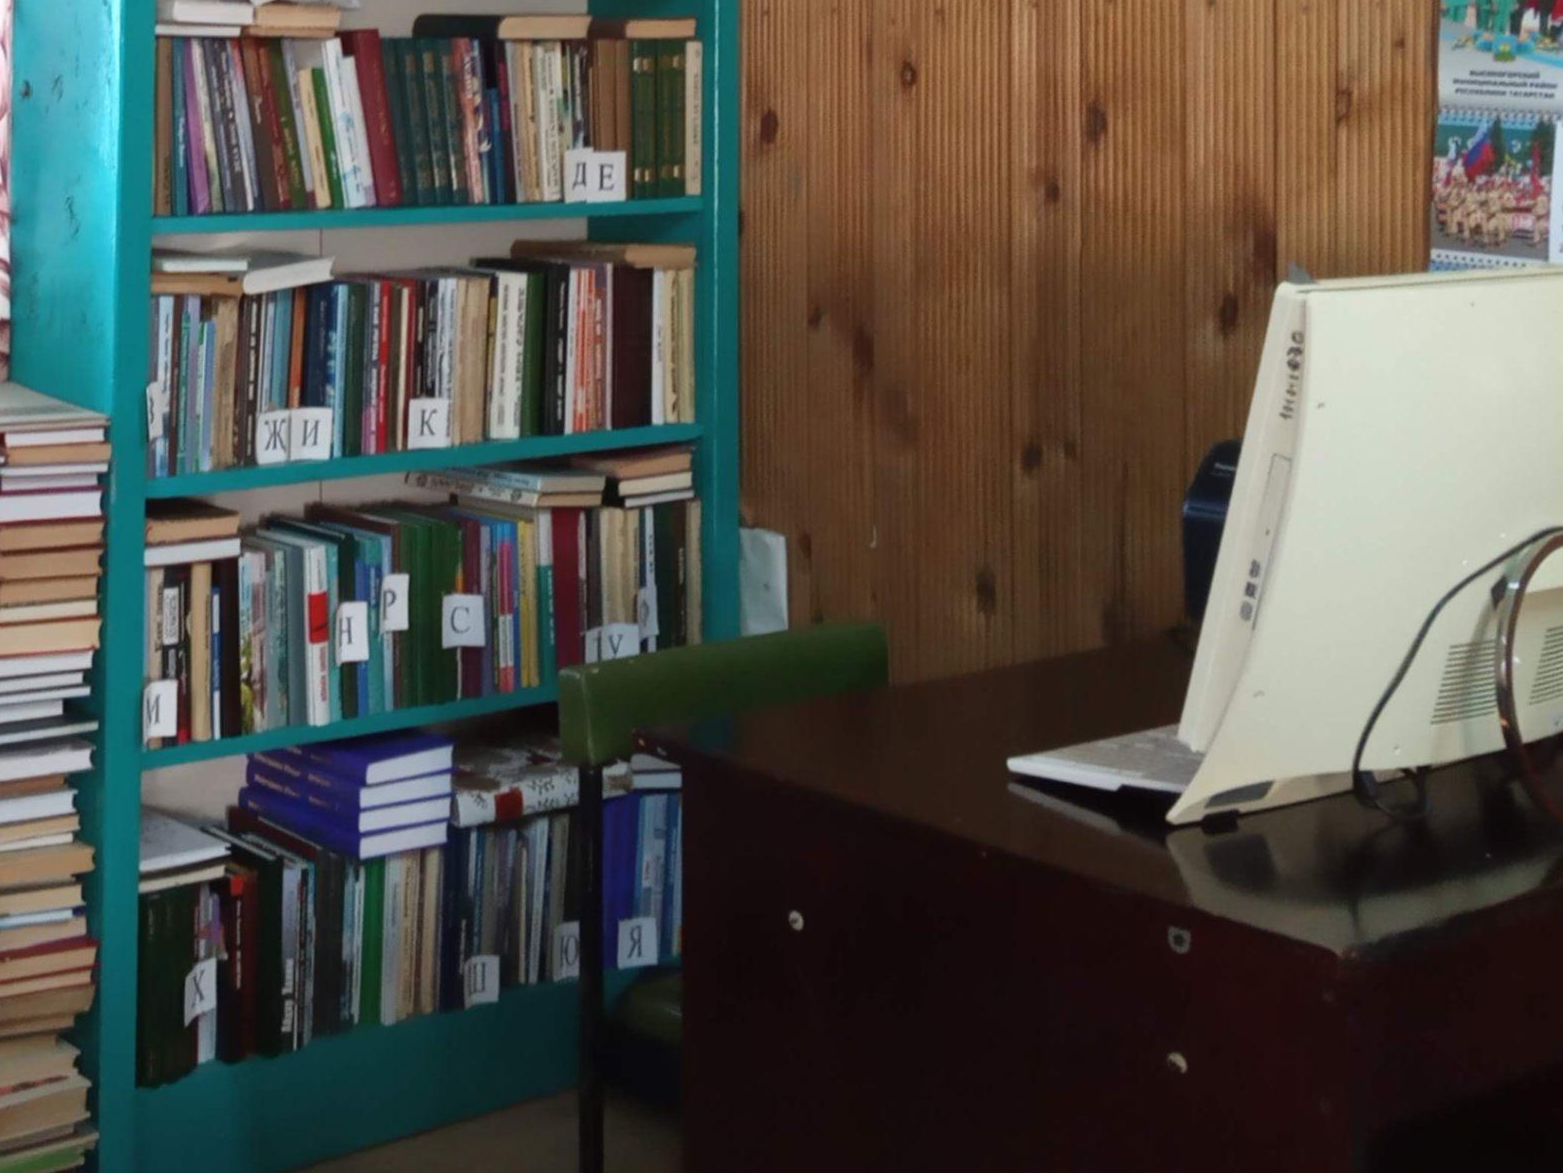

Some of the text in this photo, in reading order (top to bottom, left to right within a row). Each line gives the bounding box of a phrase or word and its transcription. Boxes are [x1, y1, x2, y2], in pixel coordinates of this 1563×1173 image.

[599, 164, 613, 190] Е
[265, 421, 286, 450] Ж
[302, 420, 319, 446] И
[420, 409, 437, 436] К
[339, 618, 351, 644] Н
[450, 607, 469, 633] С
[628, 925, 642, 958] Я
[192, 974, 206, 1005] Х
